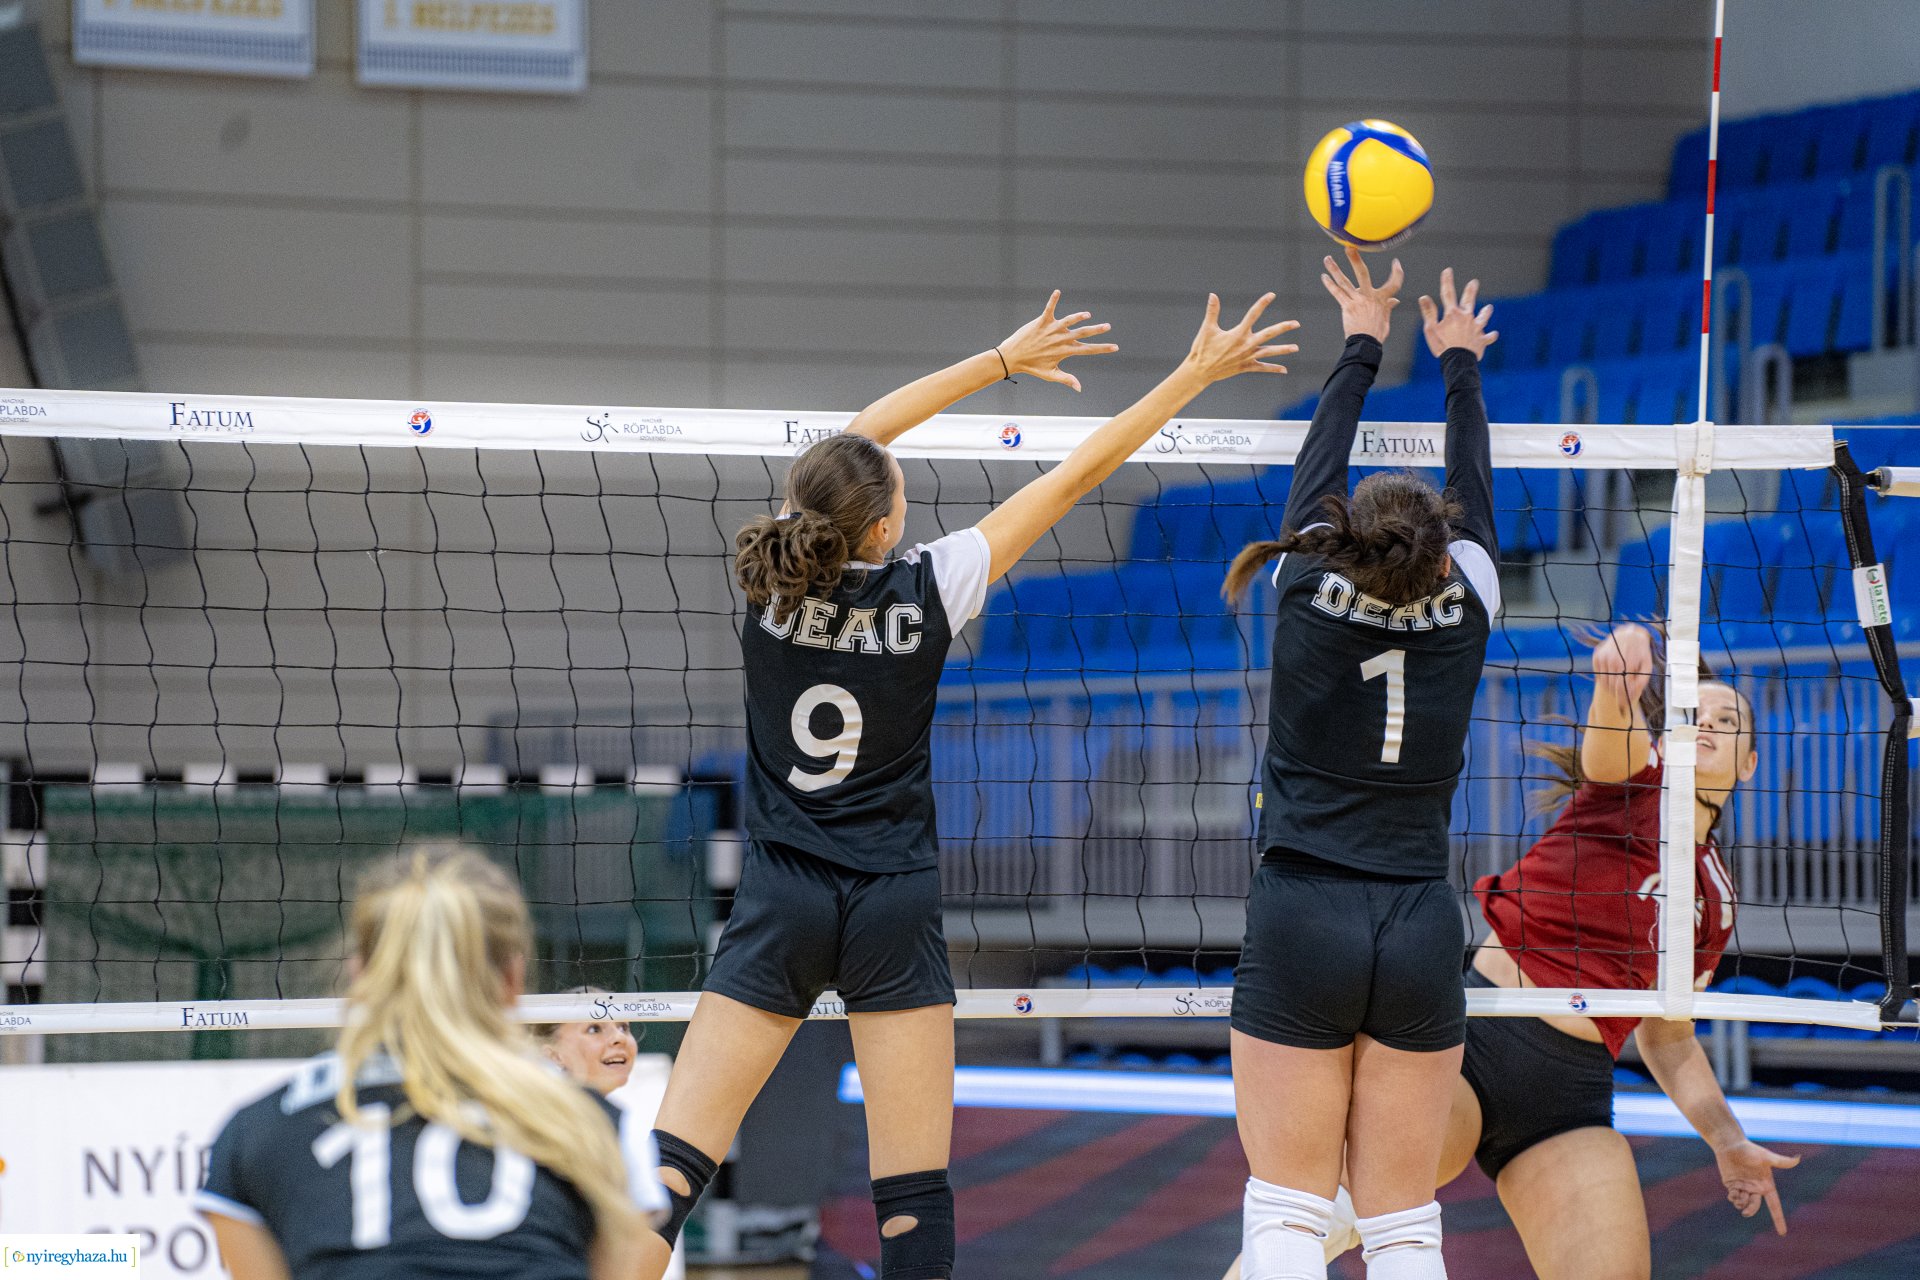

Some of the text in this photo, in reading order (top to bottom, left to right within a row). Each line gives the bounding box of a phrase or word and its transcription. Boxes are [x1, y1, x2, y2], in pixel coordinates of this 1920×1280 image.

[623, 422, 683, 435] RÖPLABDA
[1195, 433, 1252, 446] RÖPLABDA
[1360, 430, 1435, 453] FATUM
[1311, 571, 1465, 631] DEAC
[1360, 648, 1406, 764] 1
[787, 683, 864, 792] 9
[181, 1007, 249, 1026] FATUM
[311, 1101, 536, 1250] 10
